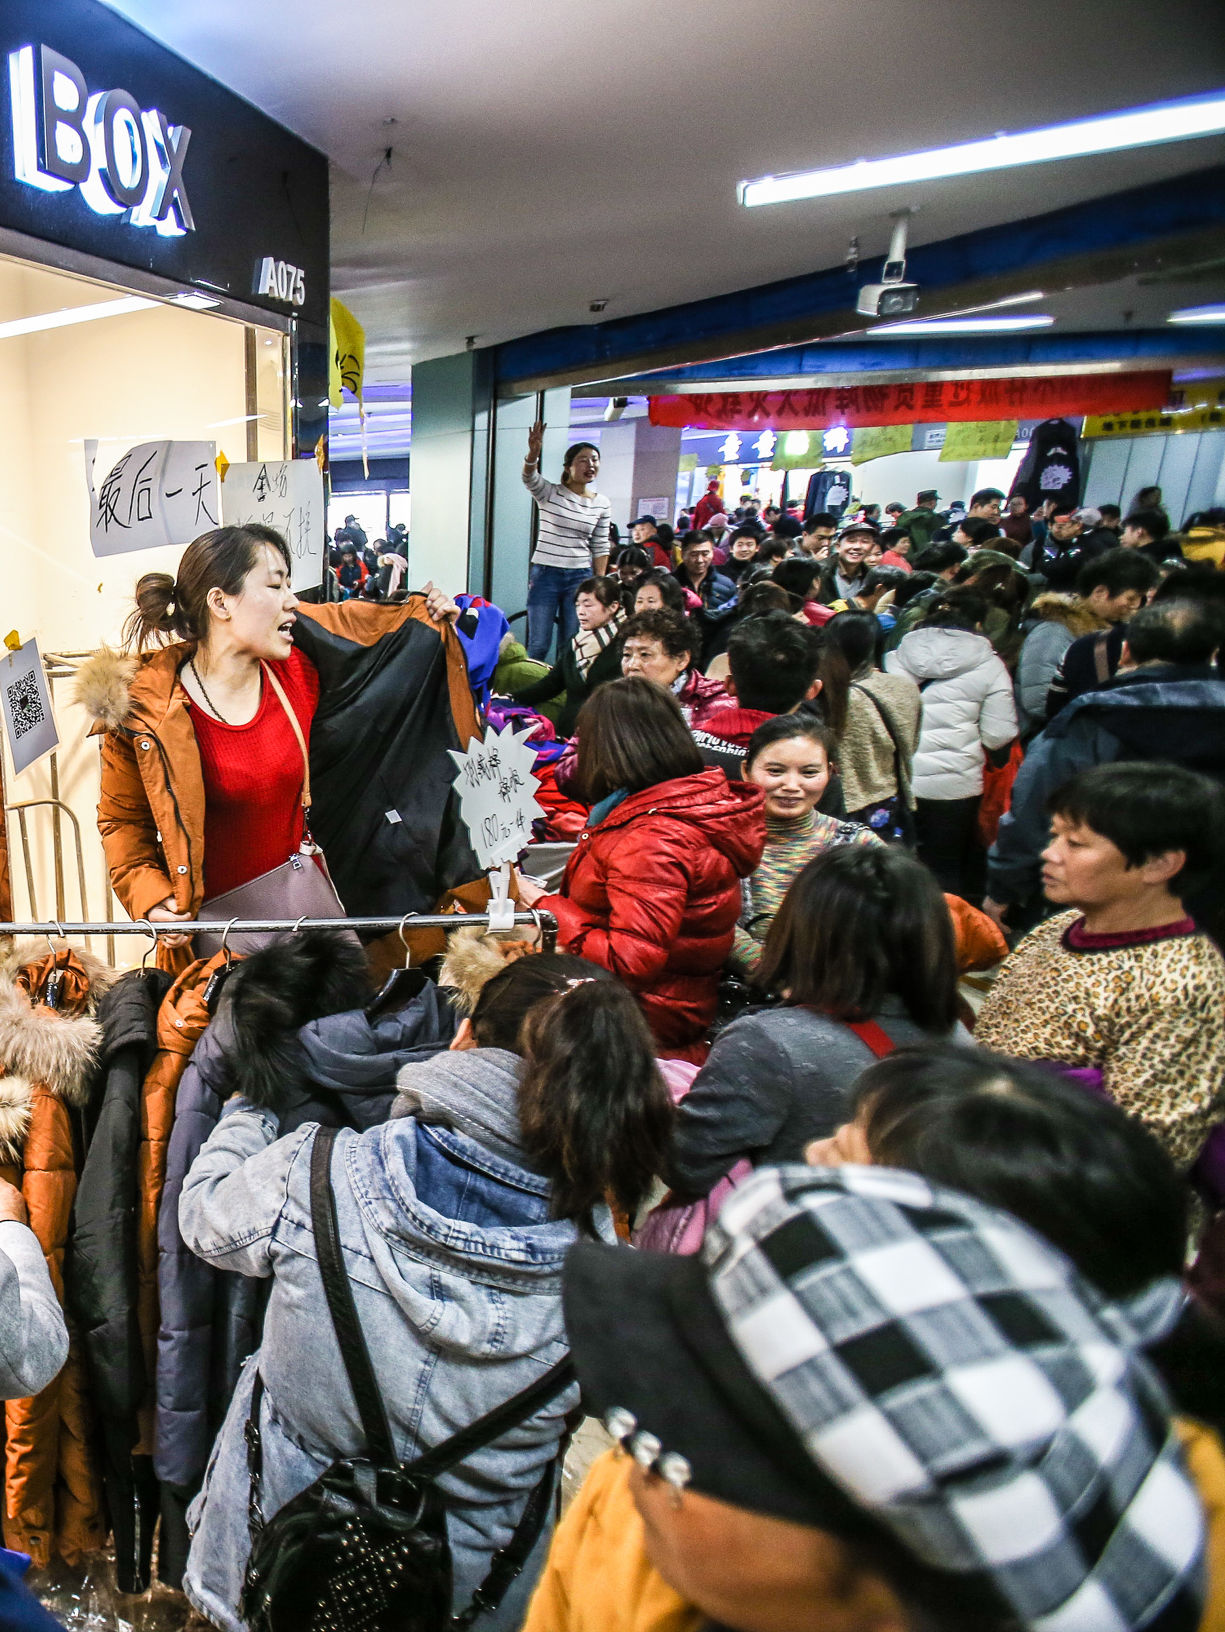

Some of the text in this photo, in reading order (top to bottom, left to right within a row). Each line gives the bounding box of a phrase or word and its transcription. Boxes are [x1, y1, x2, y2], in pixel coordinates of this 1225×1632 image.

[10, 42, 196, 236] BOX
[259, 256, 306, 306] A075
[96, 450, 219, 533] 最后一天
